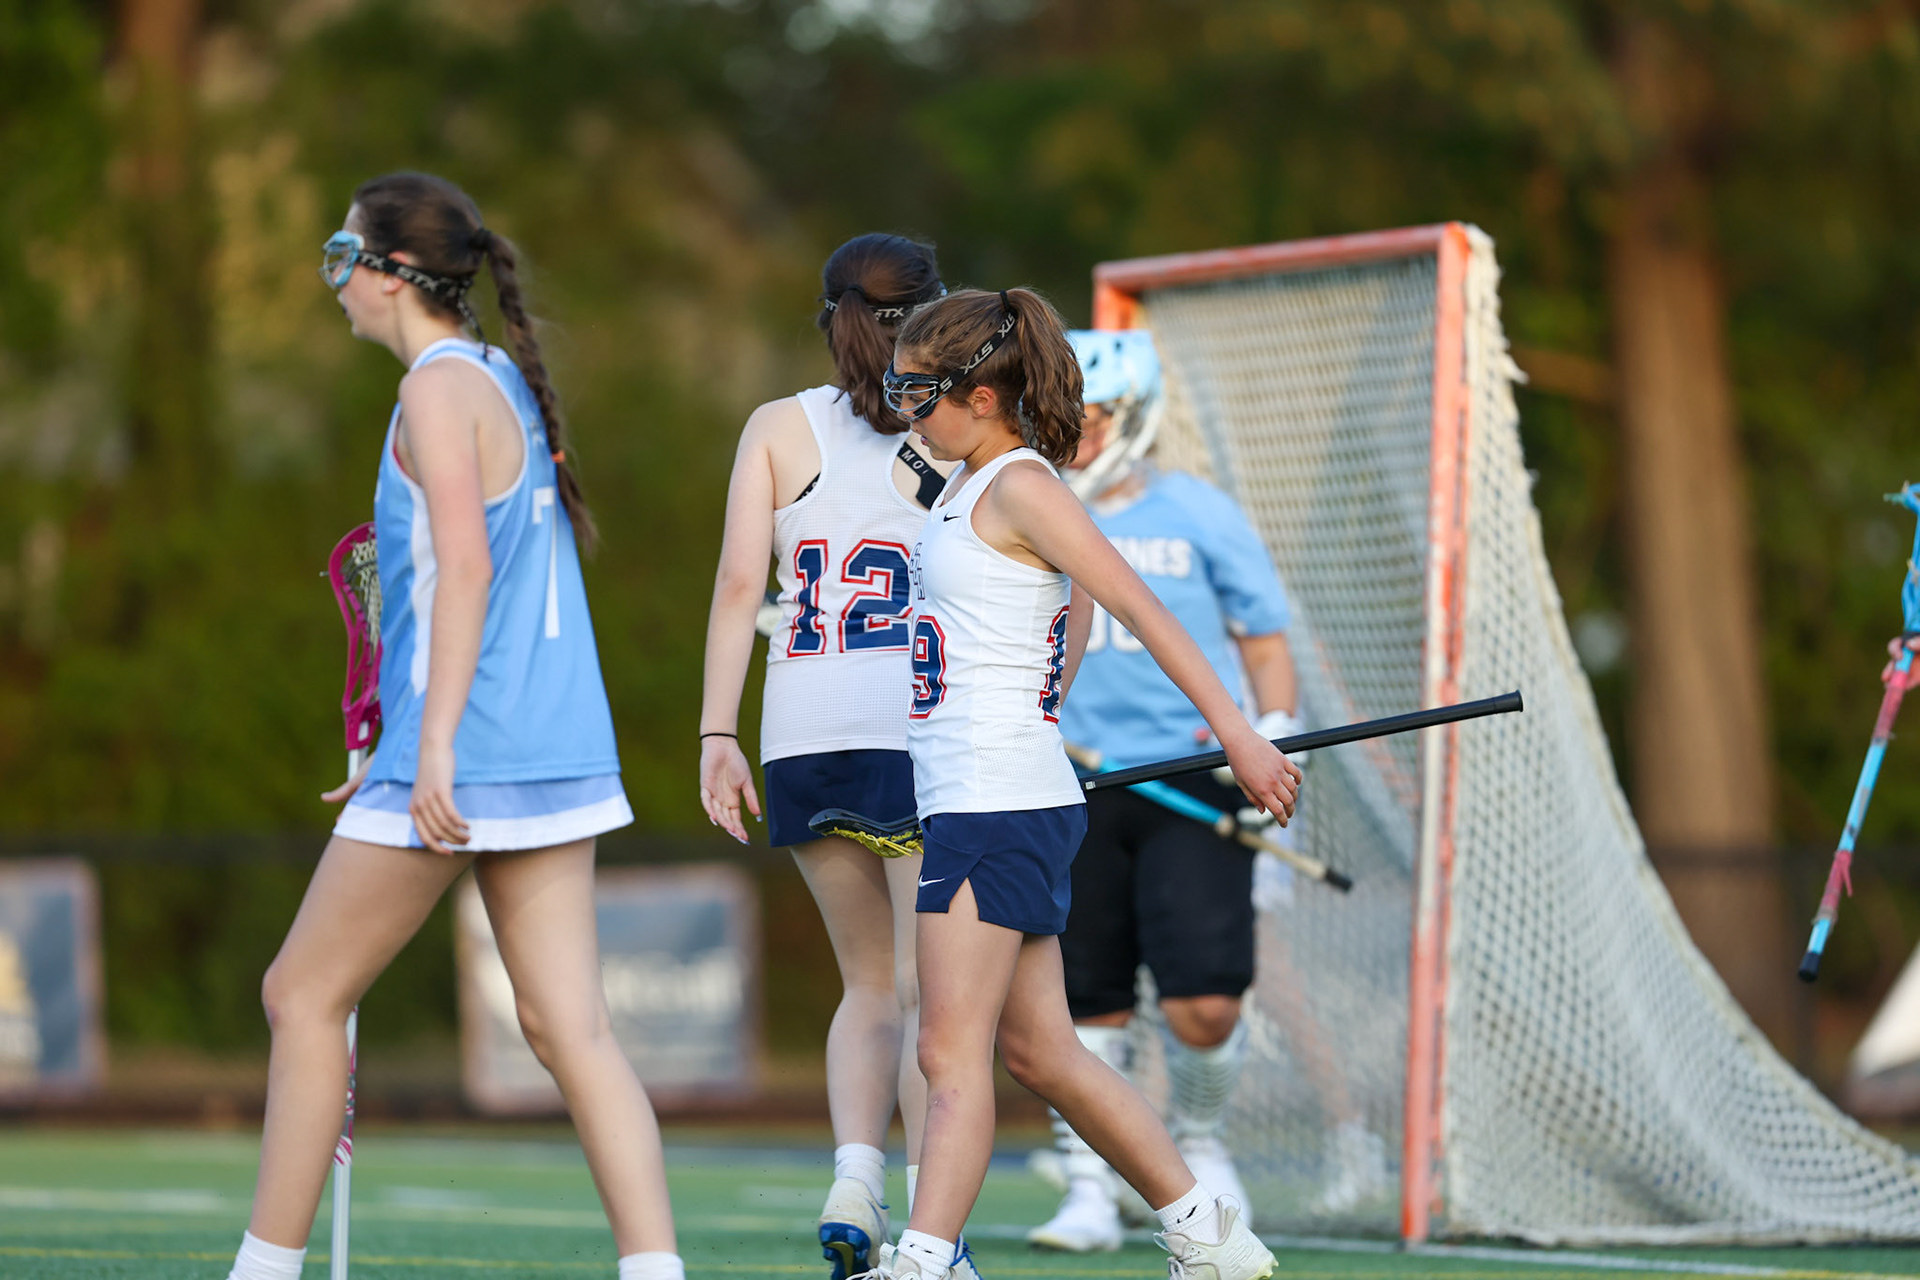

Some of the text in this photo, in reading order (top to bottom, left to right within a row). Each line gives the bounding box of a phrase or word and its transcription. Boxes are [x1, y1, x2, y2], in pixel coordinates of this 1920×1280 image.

[359, 250, 385, 270] TX
[396, 265, 438, 293] STX
[960, 341, 994, 375] STX
[787, 539, 914, 658] 12
